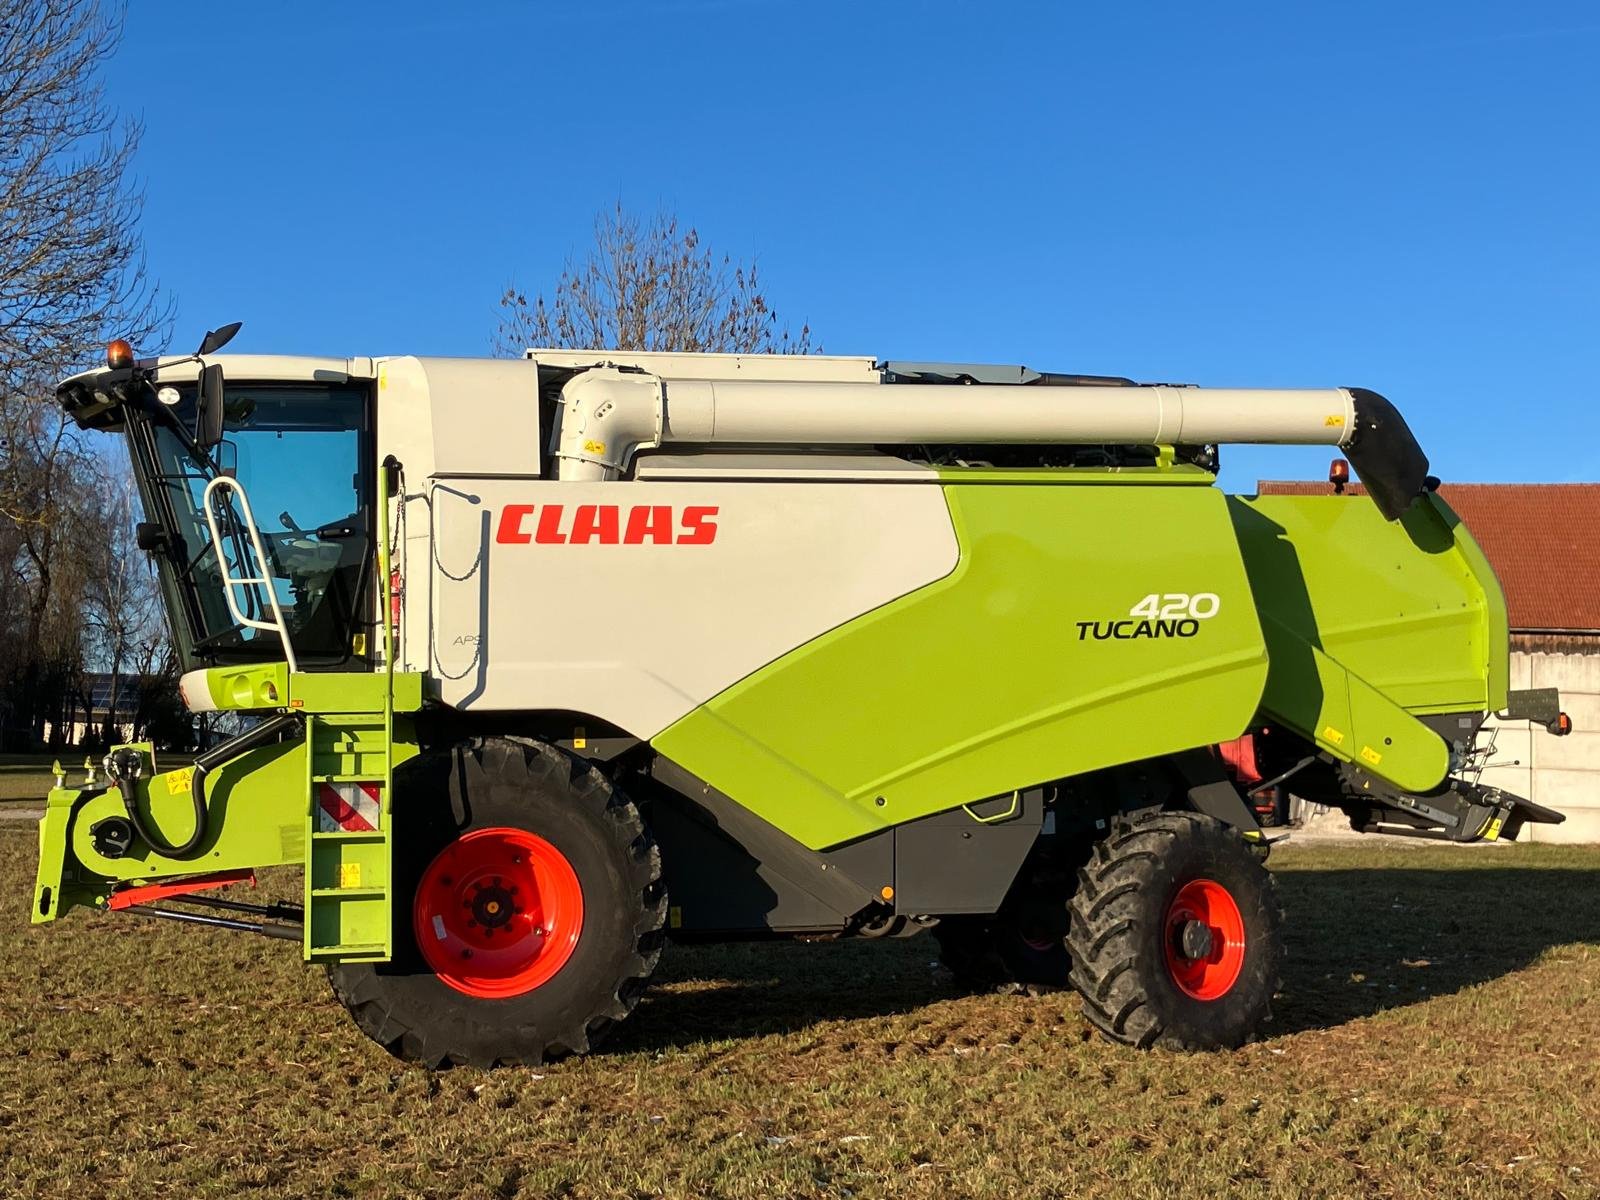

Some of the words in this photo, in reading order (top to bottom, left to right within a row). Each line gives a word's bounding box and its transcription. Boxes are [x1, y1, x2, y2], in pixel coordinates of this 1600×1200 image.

[496, 504, 719, 545] CLAAS
[1129, 592, 1221, 620] 420
[1076, 619, 1200, 641] TUCANO
